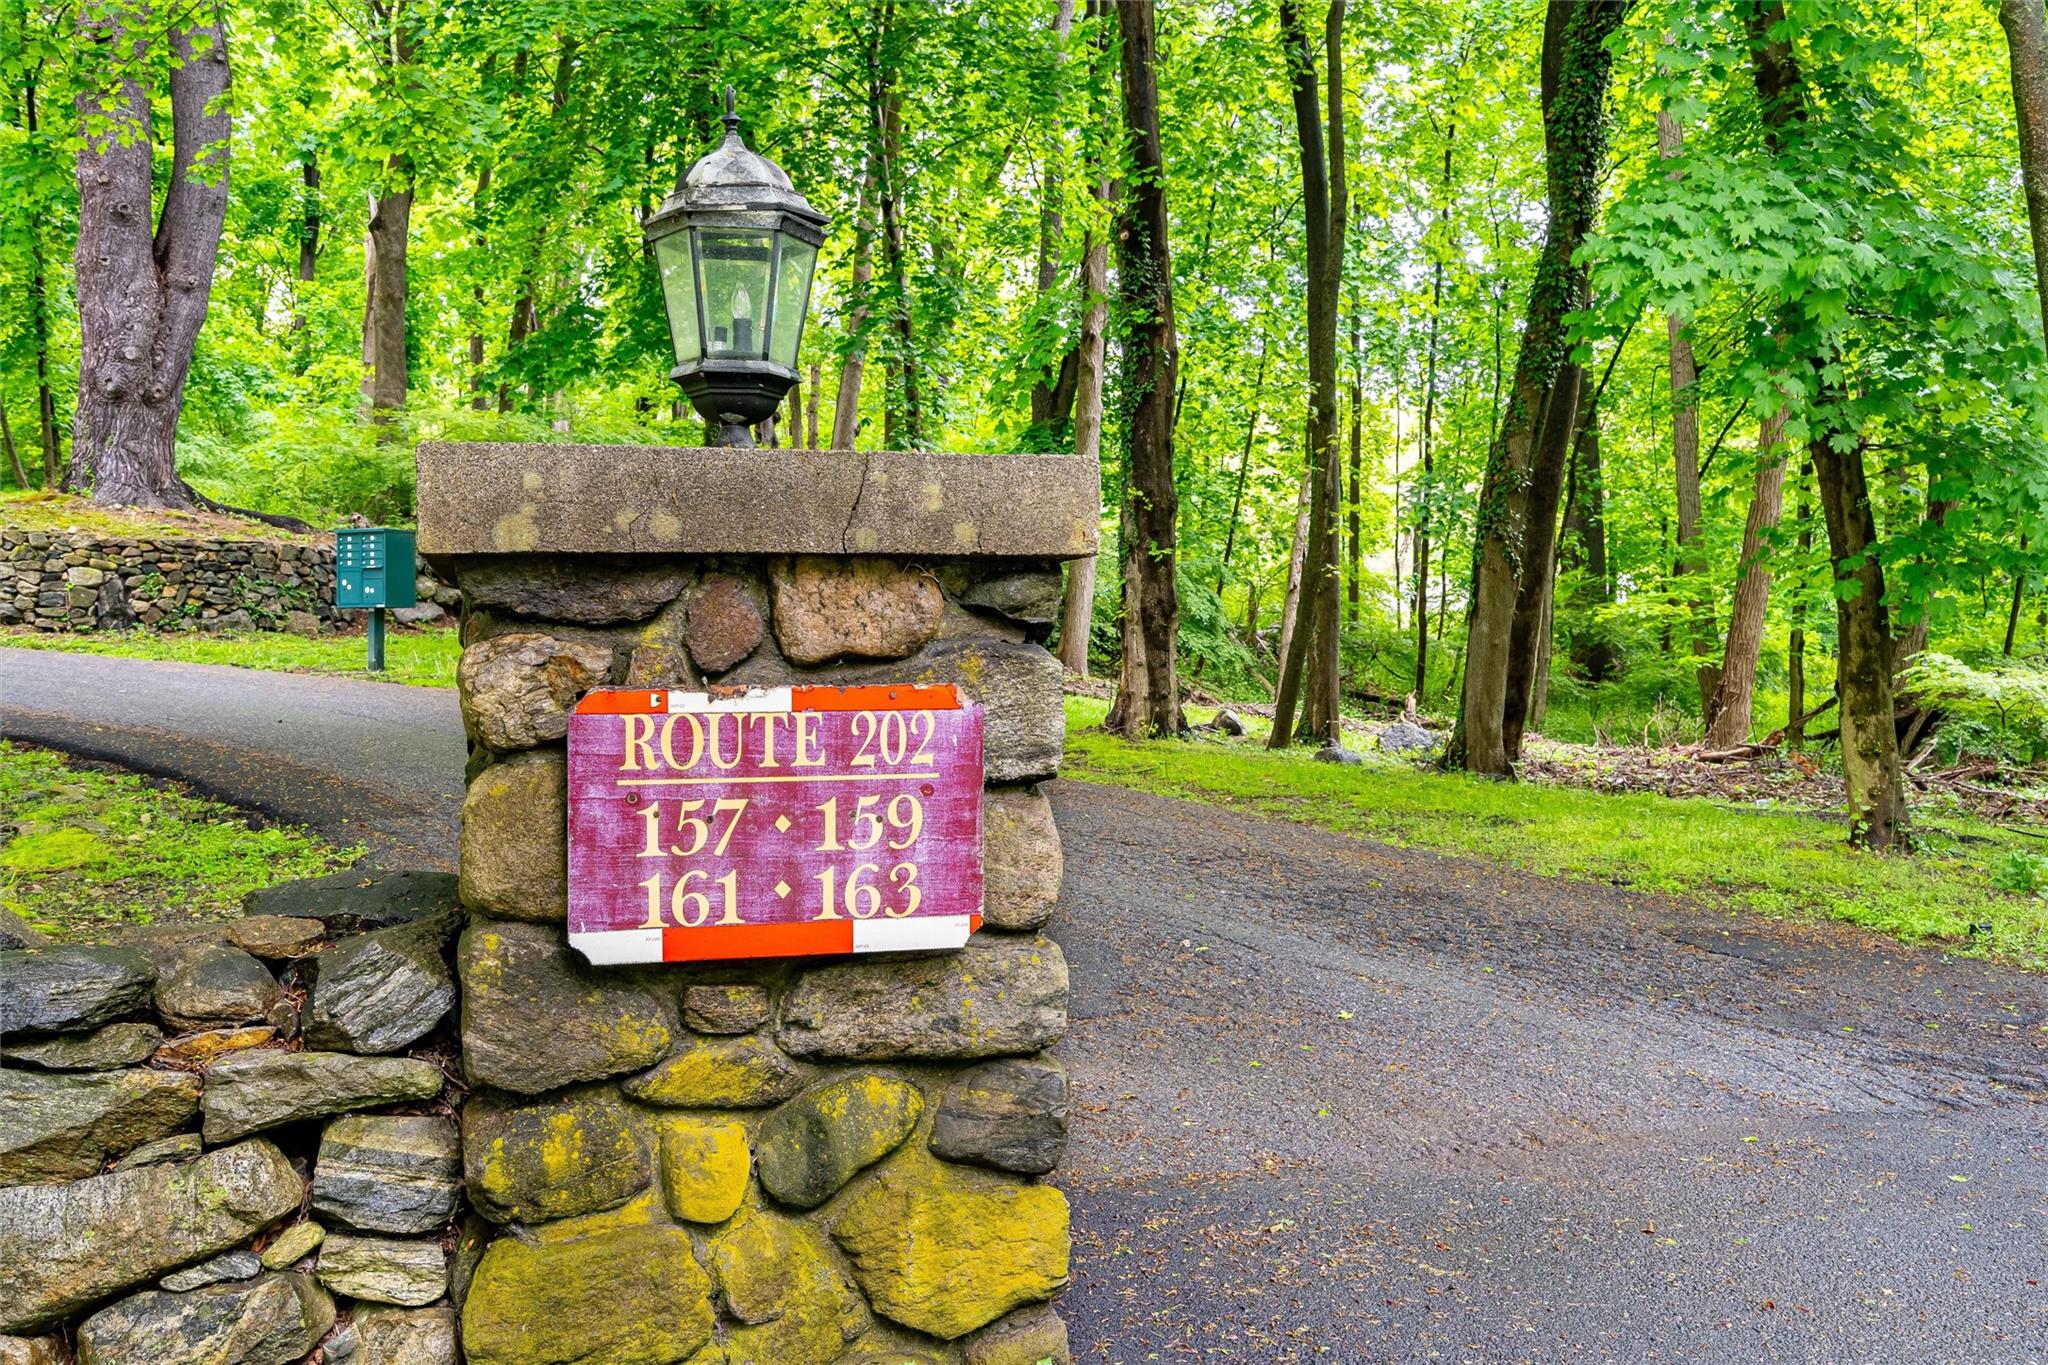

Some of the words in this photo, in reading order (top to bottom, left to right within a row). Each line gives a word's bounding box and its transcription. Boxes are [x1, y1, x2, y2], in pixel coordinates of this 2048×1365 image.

[619, 711, 826, 771] ROUTE
[850, 711, 936, 767] 202
[636, 798, 750, 858] 157
[814, 794, 923, 852] 159
[637, 868, 746, 929] 161
[812, 862, 923, 920] 163
